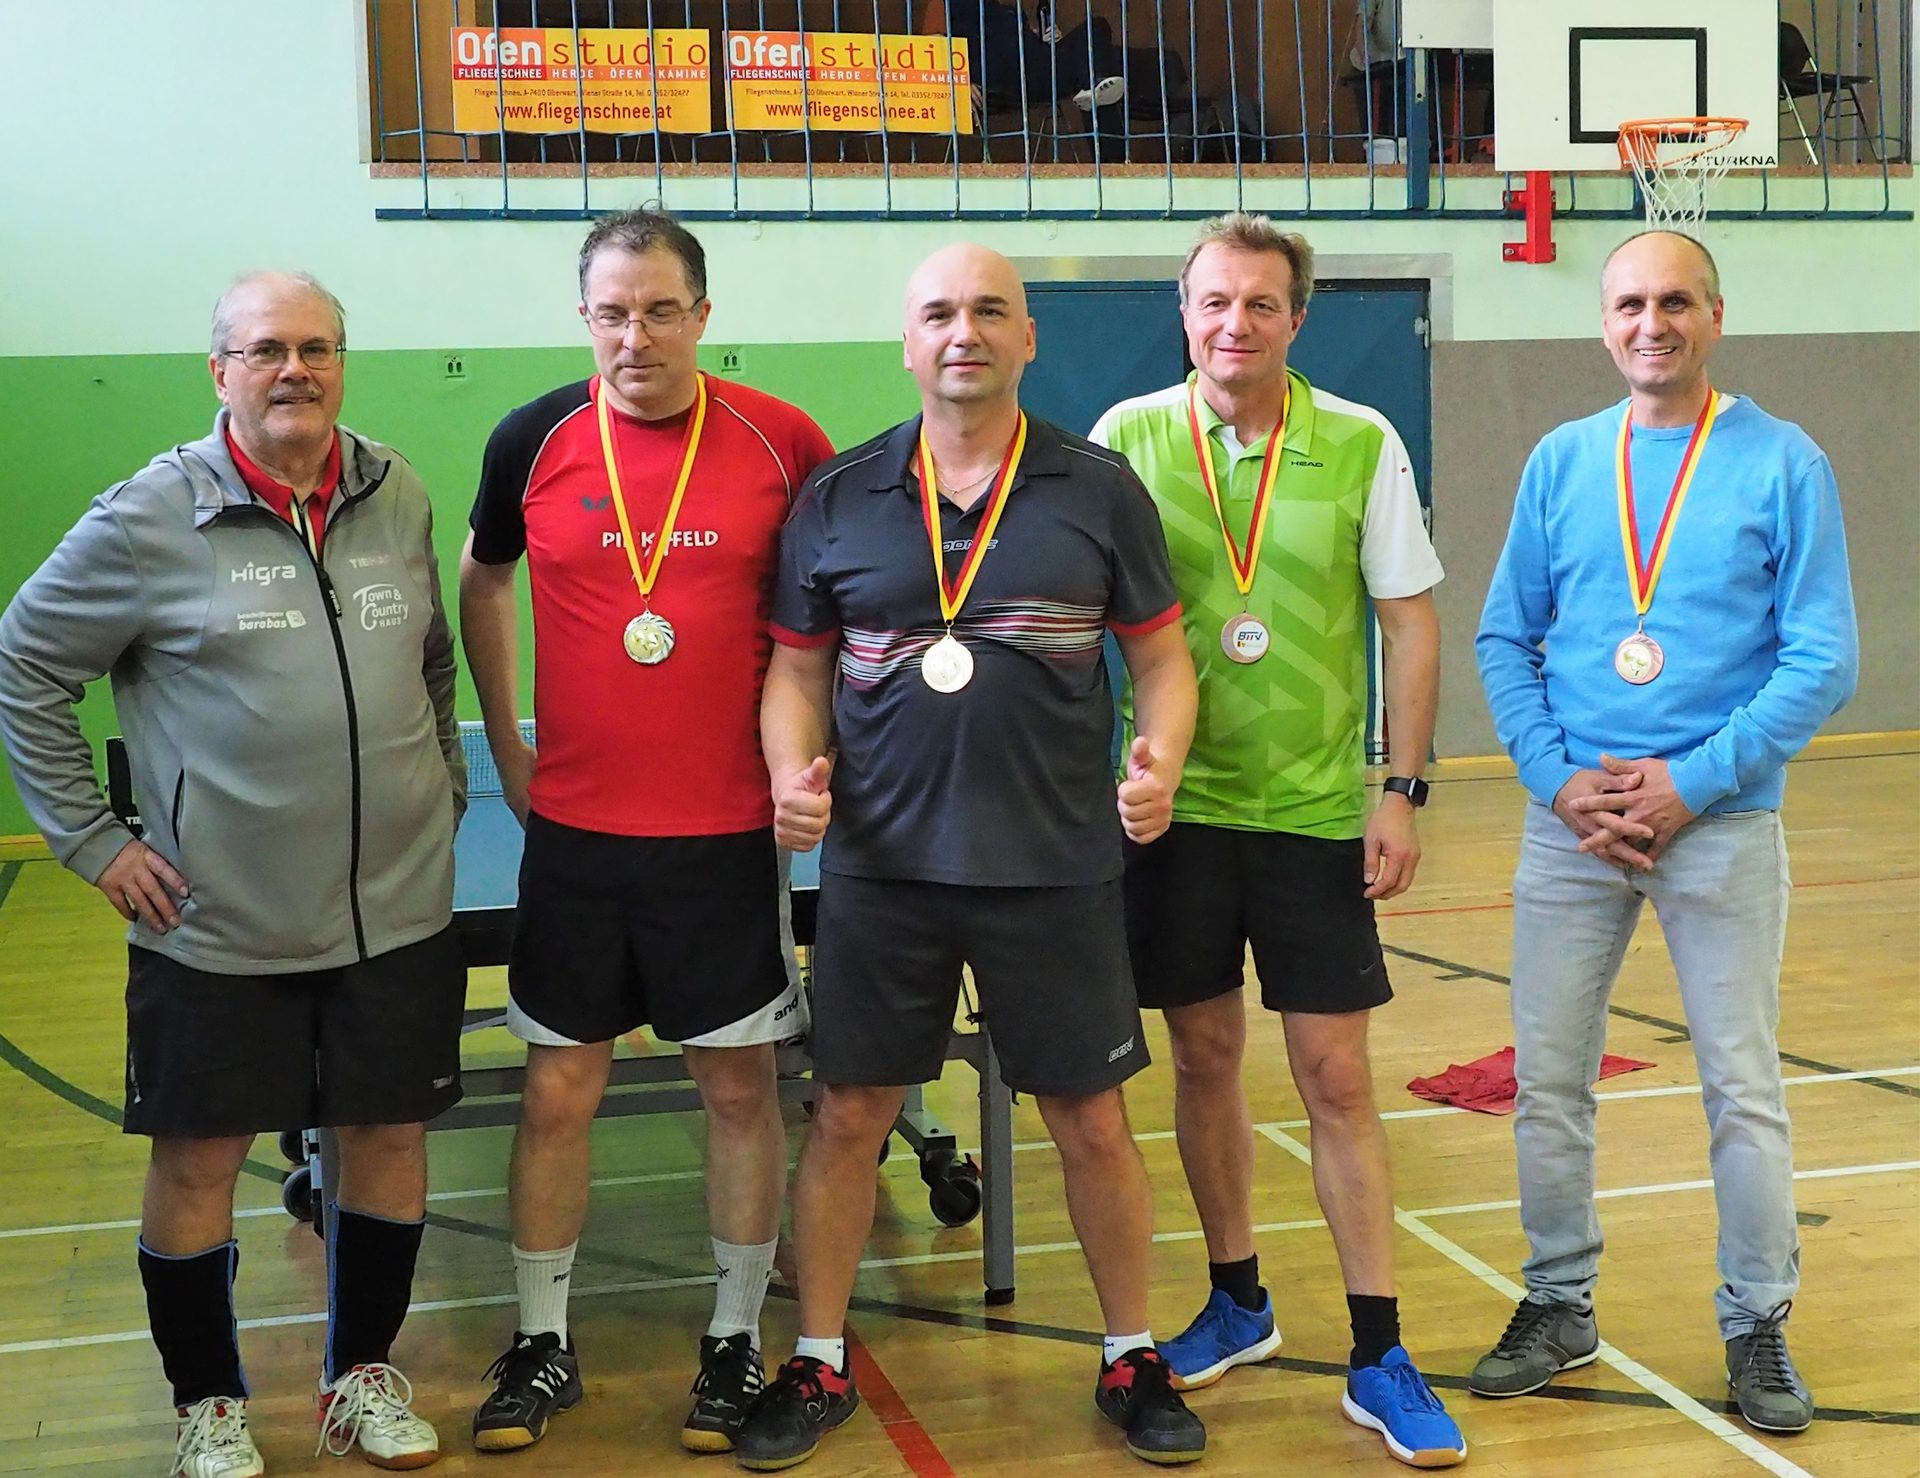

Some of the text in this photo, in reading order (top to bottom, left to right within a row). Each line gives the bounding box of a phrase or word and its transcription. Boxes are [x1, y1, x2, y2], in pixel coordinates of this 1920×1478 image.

[457, 31, 707, 66] Ofen studio
[730, 35, 966, 71] Ofen studio
[658, 69, 707, 79] KAMINE
[820, 70, 862, 79] HERDE
[602, 530, 719, 549] PIKFELD
[353, 583, 396, 608] Town
[361, 602, 409, 631] Country
